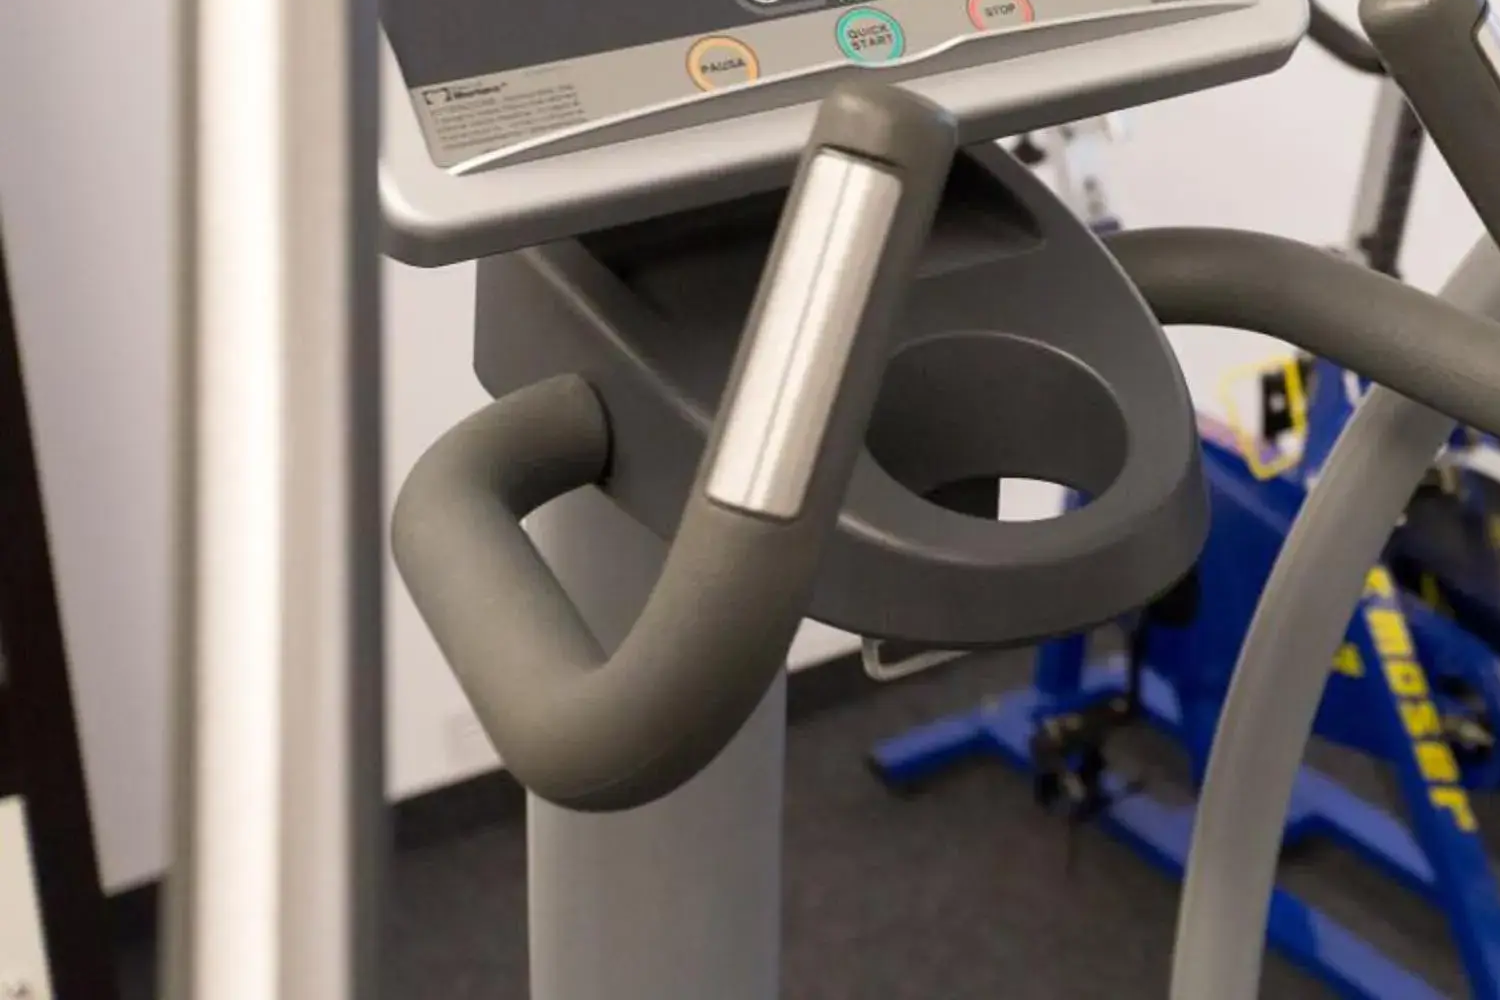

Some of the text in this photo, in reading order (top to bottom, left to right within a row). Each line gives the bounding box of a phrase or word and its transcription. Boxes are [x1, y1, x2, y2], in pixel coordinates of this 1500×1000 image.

[984, 2, 1017, 18] STOP
[847, 24, 890, 40] QUICK
[852, 34, 894, 51] START
[700, 56, 746, 74] PAUSA
